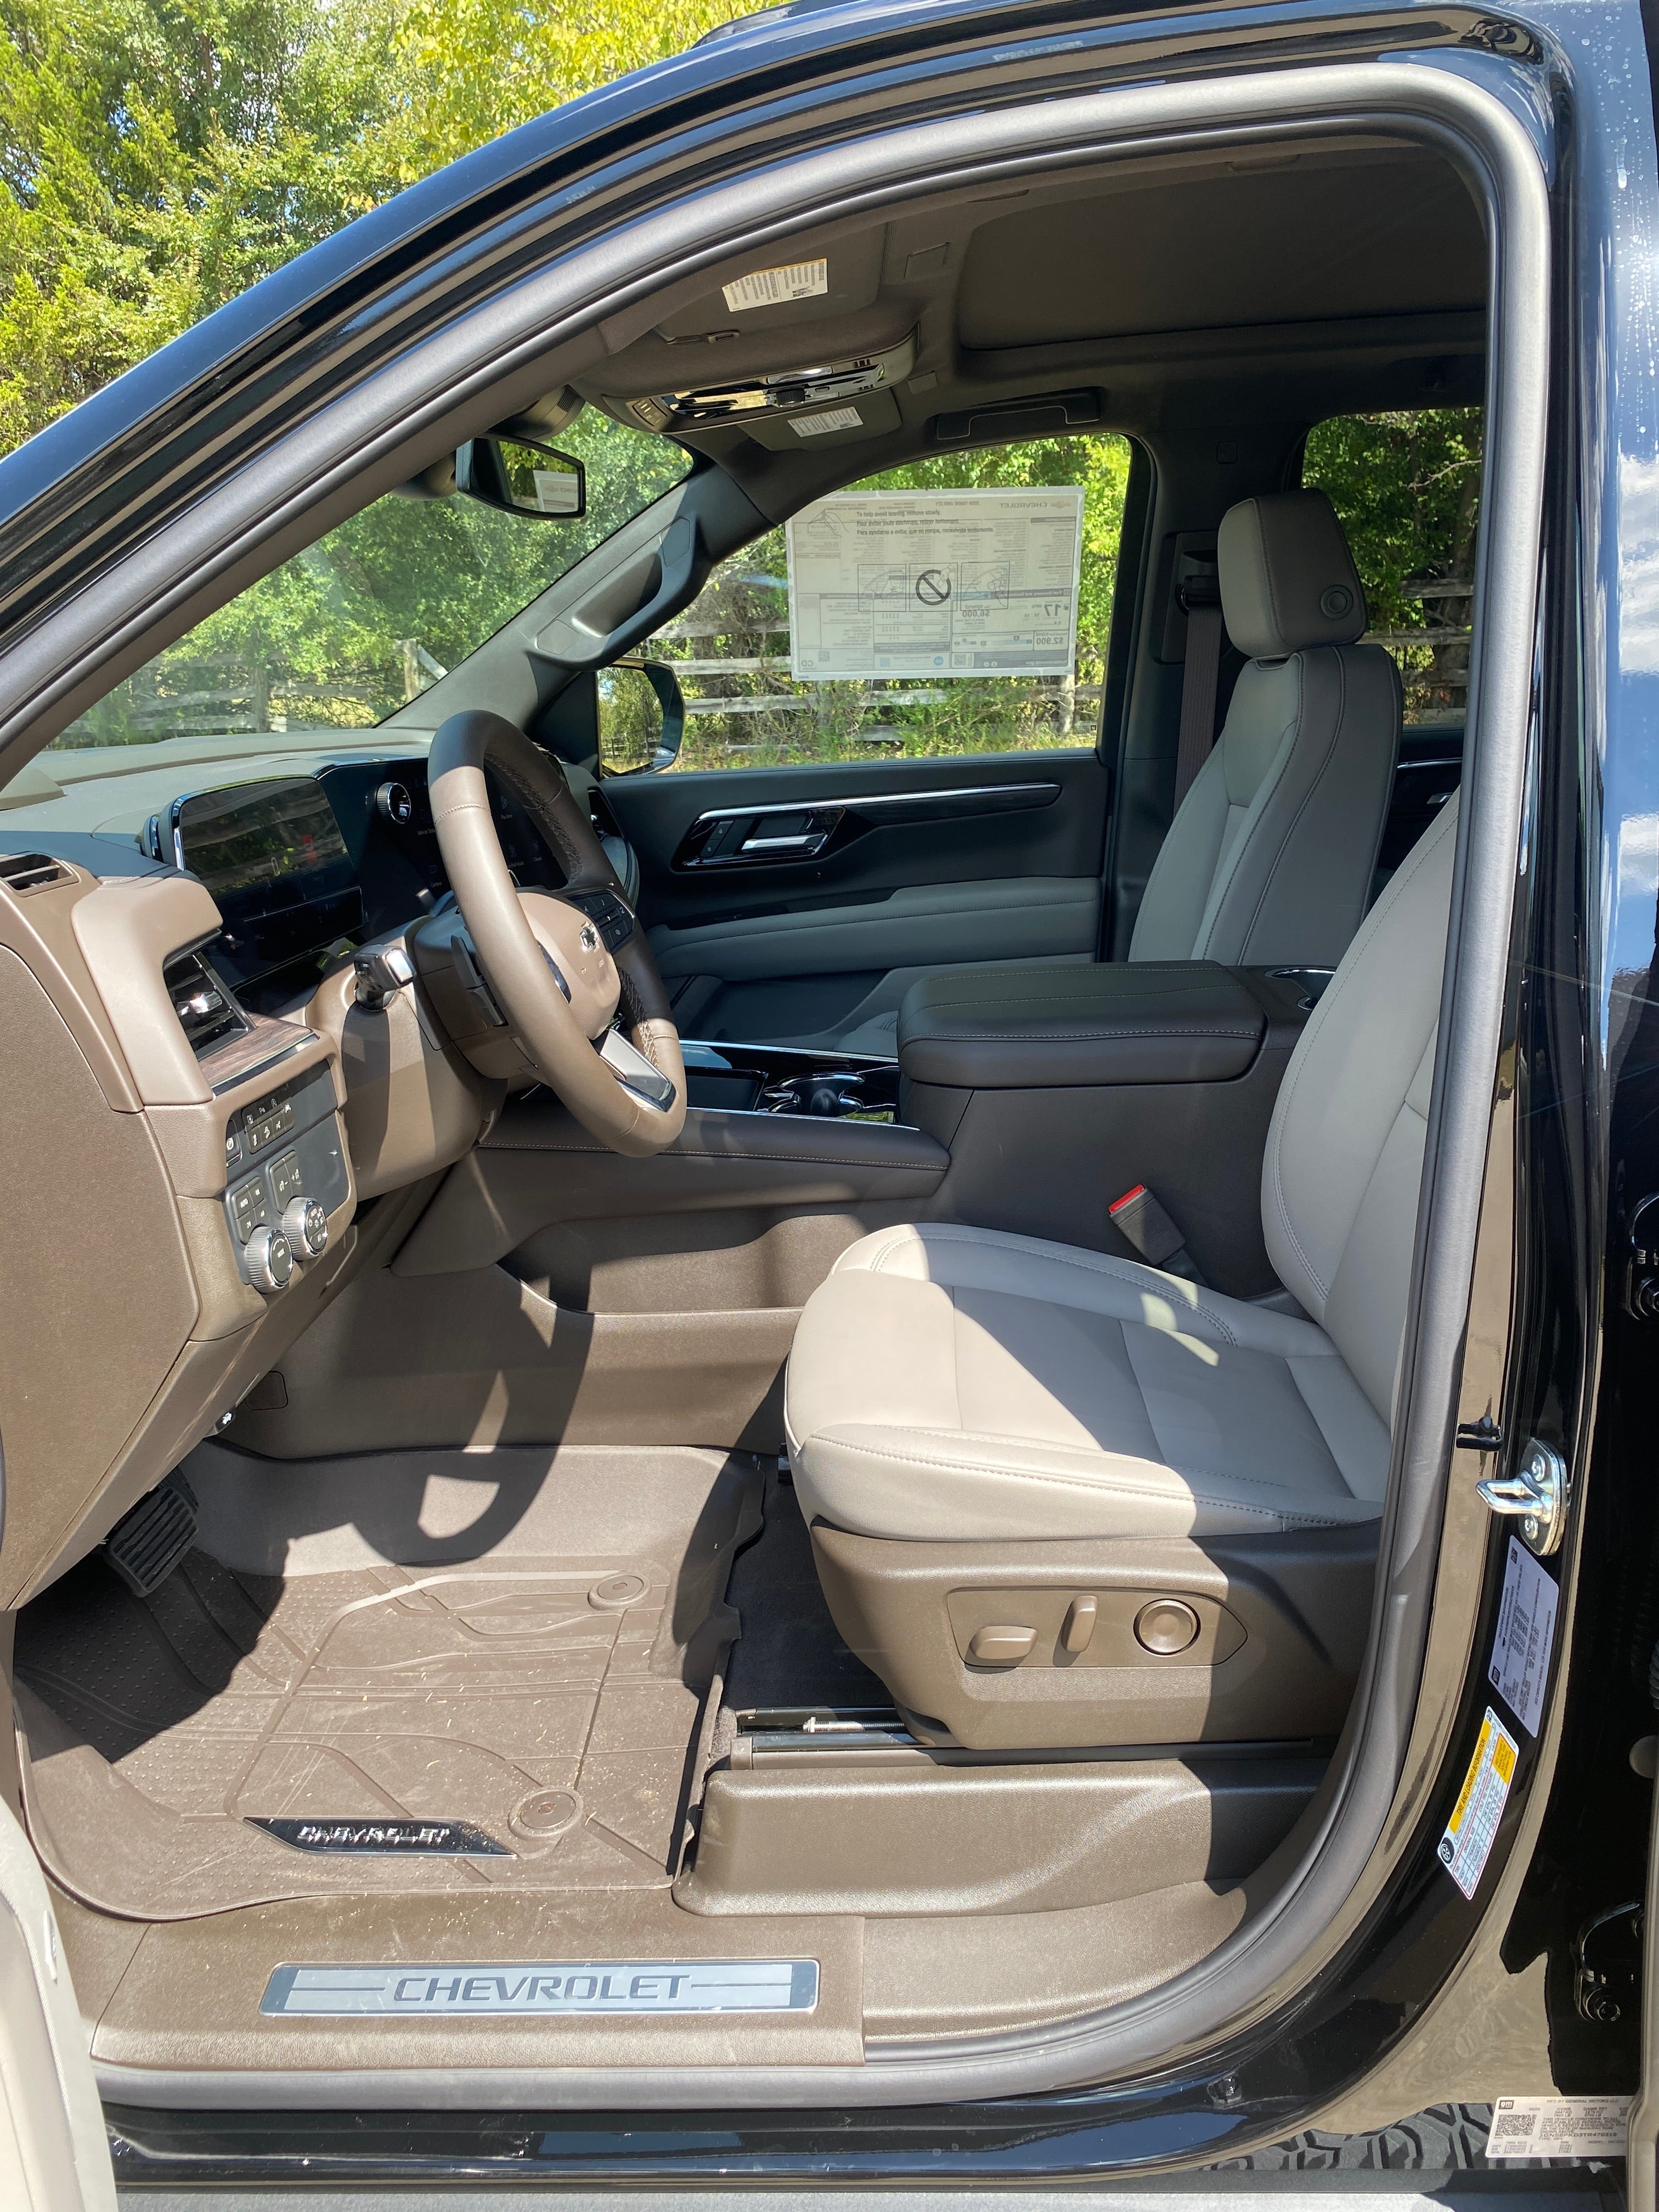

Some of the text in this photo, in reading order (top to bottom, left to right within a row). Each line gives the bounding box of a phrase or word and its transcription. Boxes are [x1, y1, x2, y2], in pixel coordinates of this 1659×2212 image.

[1492, 1667, 1499, 1683] gm
[1465, 1770, 1475, 1794] LOADING
[1472, 1738, 1485, 1771] INFORMATION
[394, 1974, 691, 2002] CHEVROLET
